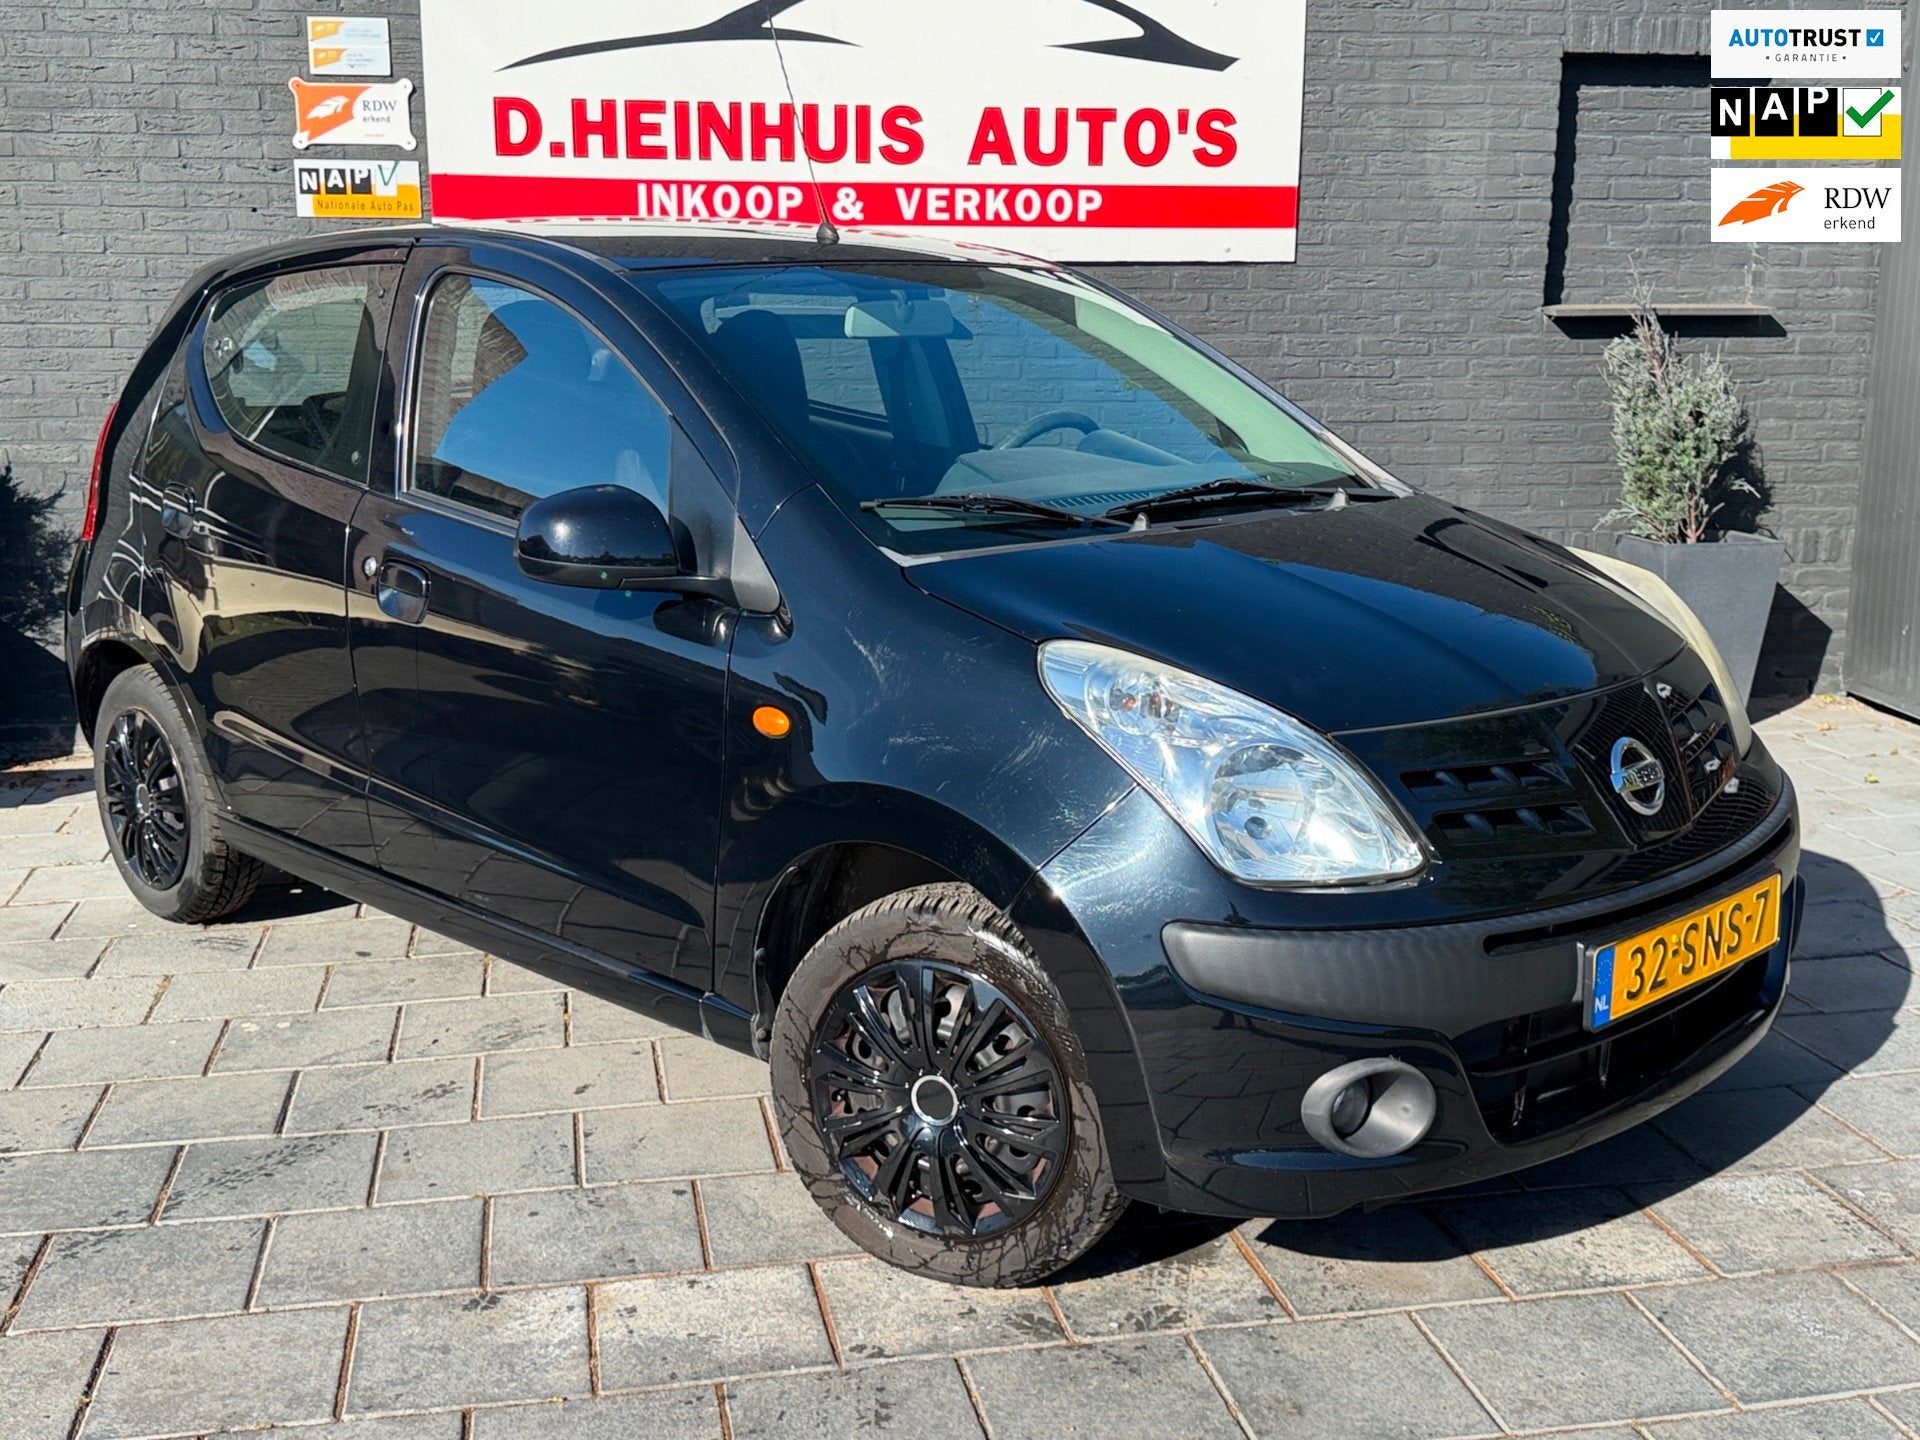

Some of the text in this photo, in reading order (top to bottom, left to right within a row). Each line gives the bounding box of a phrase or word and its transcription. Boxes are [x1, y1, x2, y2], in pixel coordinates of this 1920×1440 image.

[362, 100, 398, 112] RDW
[362, 115, 391, 124] erkend
[493, 96, 1239, 168] D.HEINHUIS AUTO'S
[317, 200, 414, 212] Nationale Auto Pas
[636, 182, 1104, 223] INKOOP & VERKOOP
[1623, 886, 1770, 1001] 32-SNS-7
[1595, 994, 1610, 1014] NL
